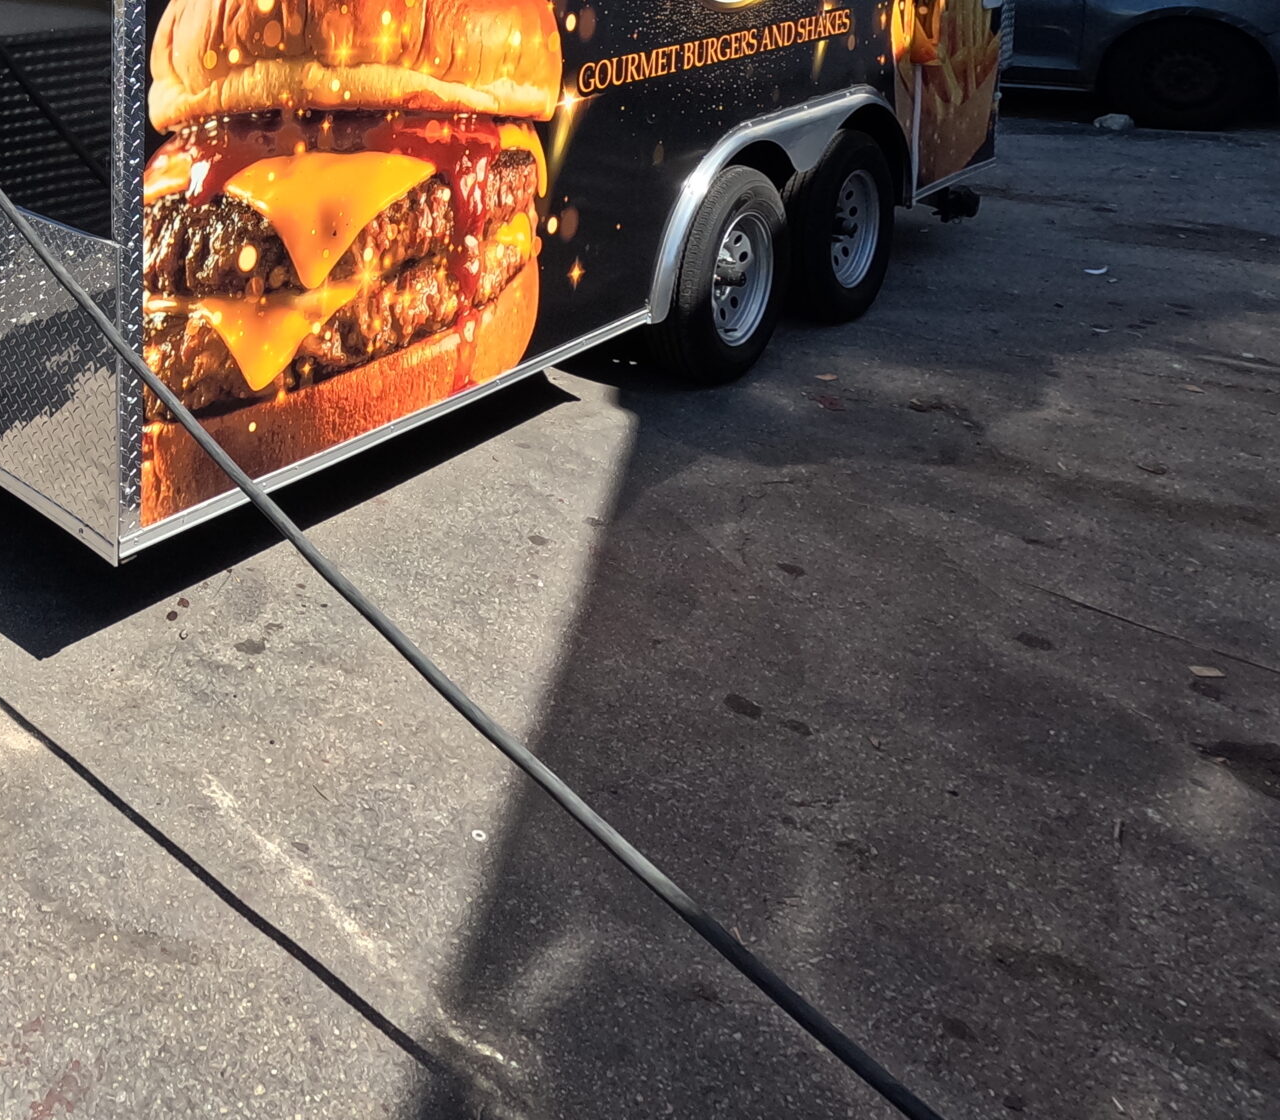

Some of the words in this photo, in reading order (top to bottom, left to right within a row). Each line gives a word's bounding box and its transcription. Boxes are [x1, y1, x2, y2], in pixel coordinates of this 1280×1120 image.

[578, 45, 681, 93] GOURMET
[683, 29, 758, 70] BURGERS
[760, 22, 796, 51] AND
[797, 10, 851, 43] SHAKES
